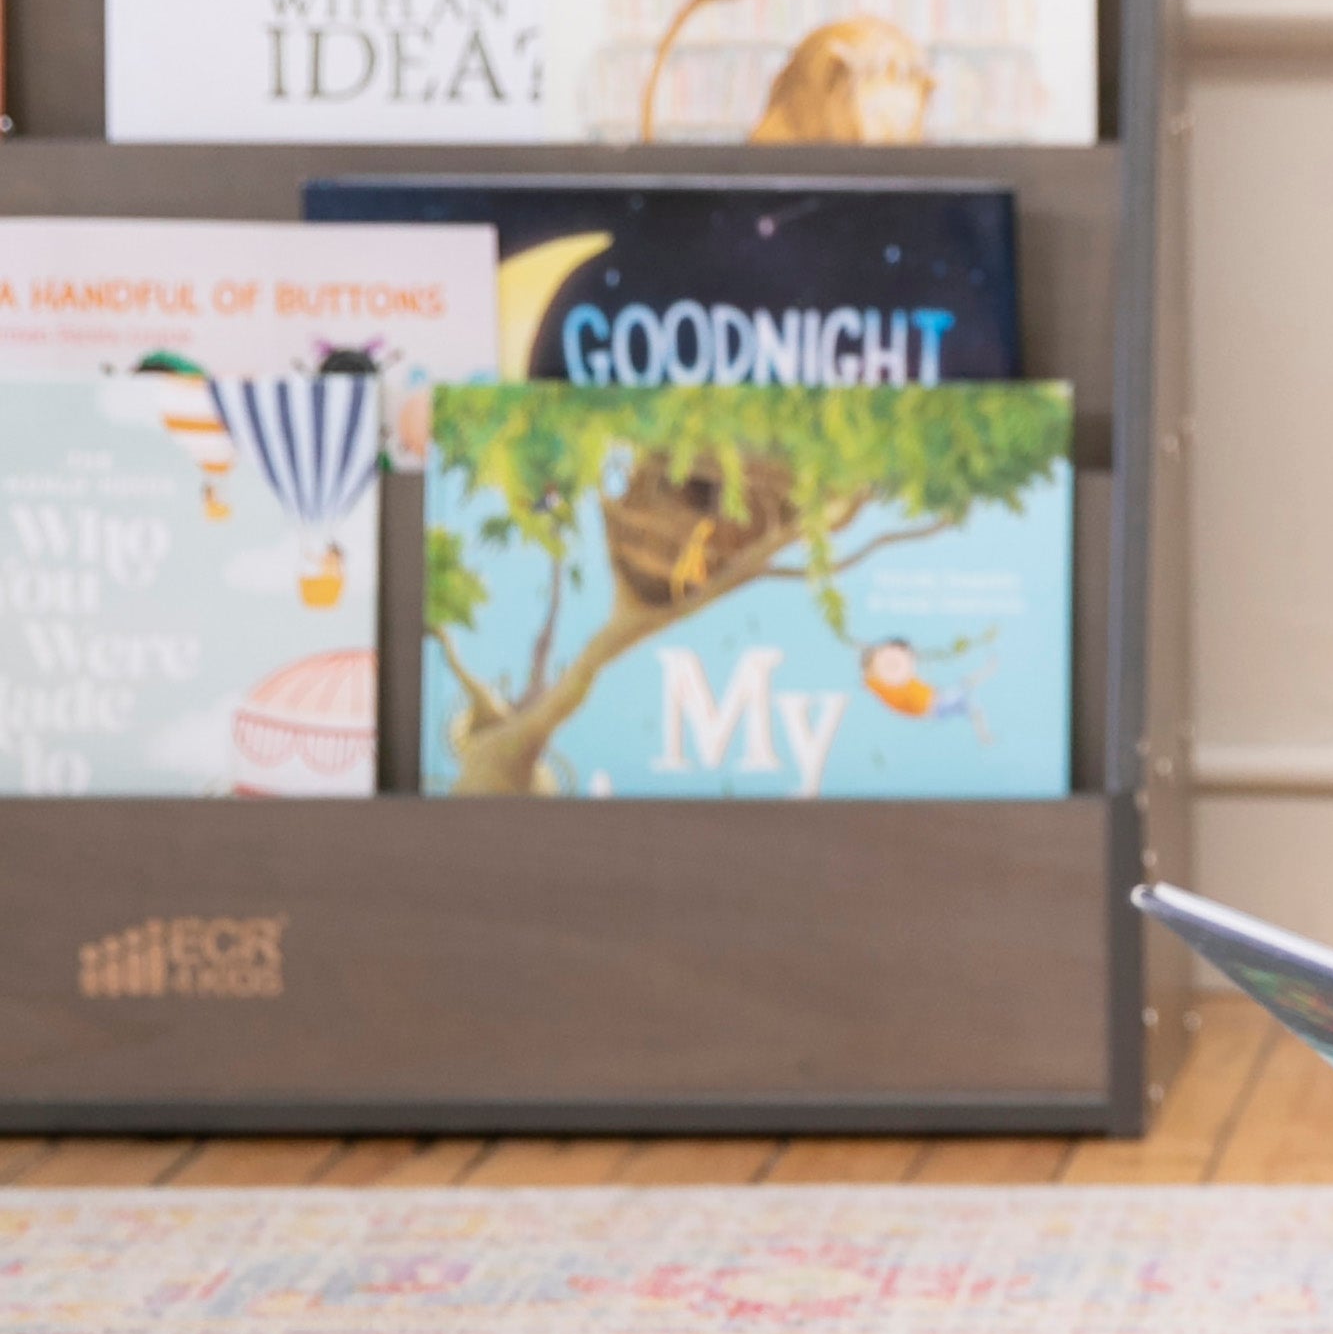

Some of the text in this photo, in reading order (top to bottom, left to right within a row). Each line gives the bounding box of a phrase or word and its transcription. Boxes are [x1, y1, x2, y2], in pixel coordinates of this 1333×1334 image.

[29, 279, 201, 316] HANDFUL
[274, 282, 447, 319] BUTTONS
[563, 300, 955, 385] GOODNIGHT
[652, 647, 846, 798] My
